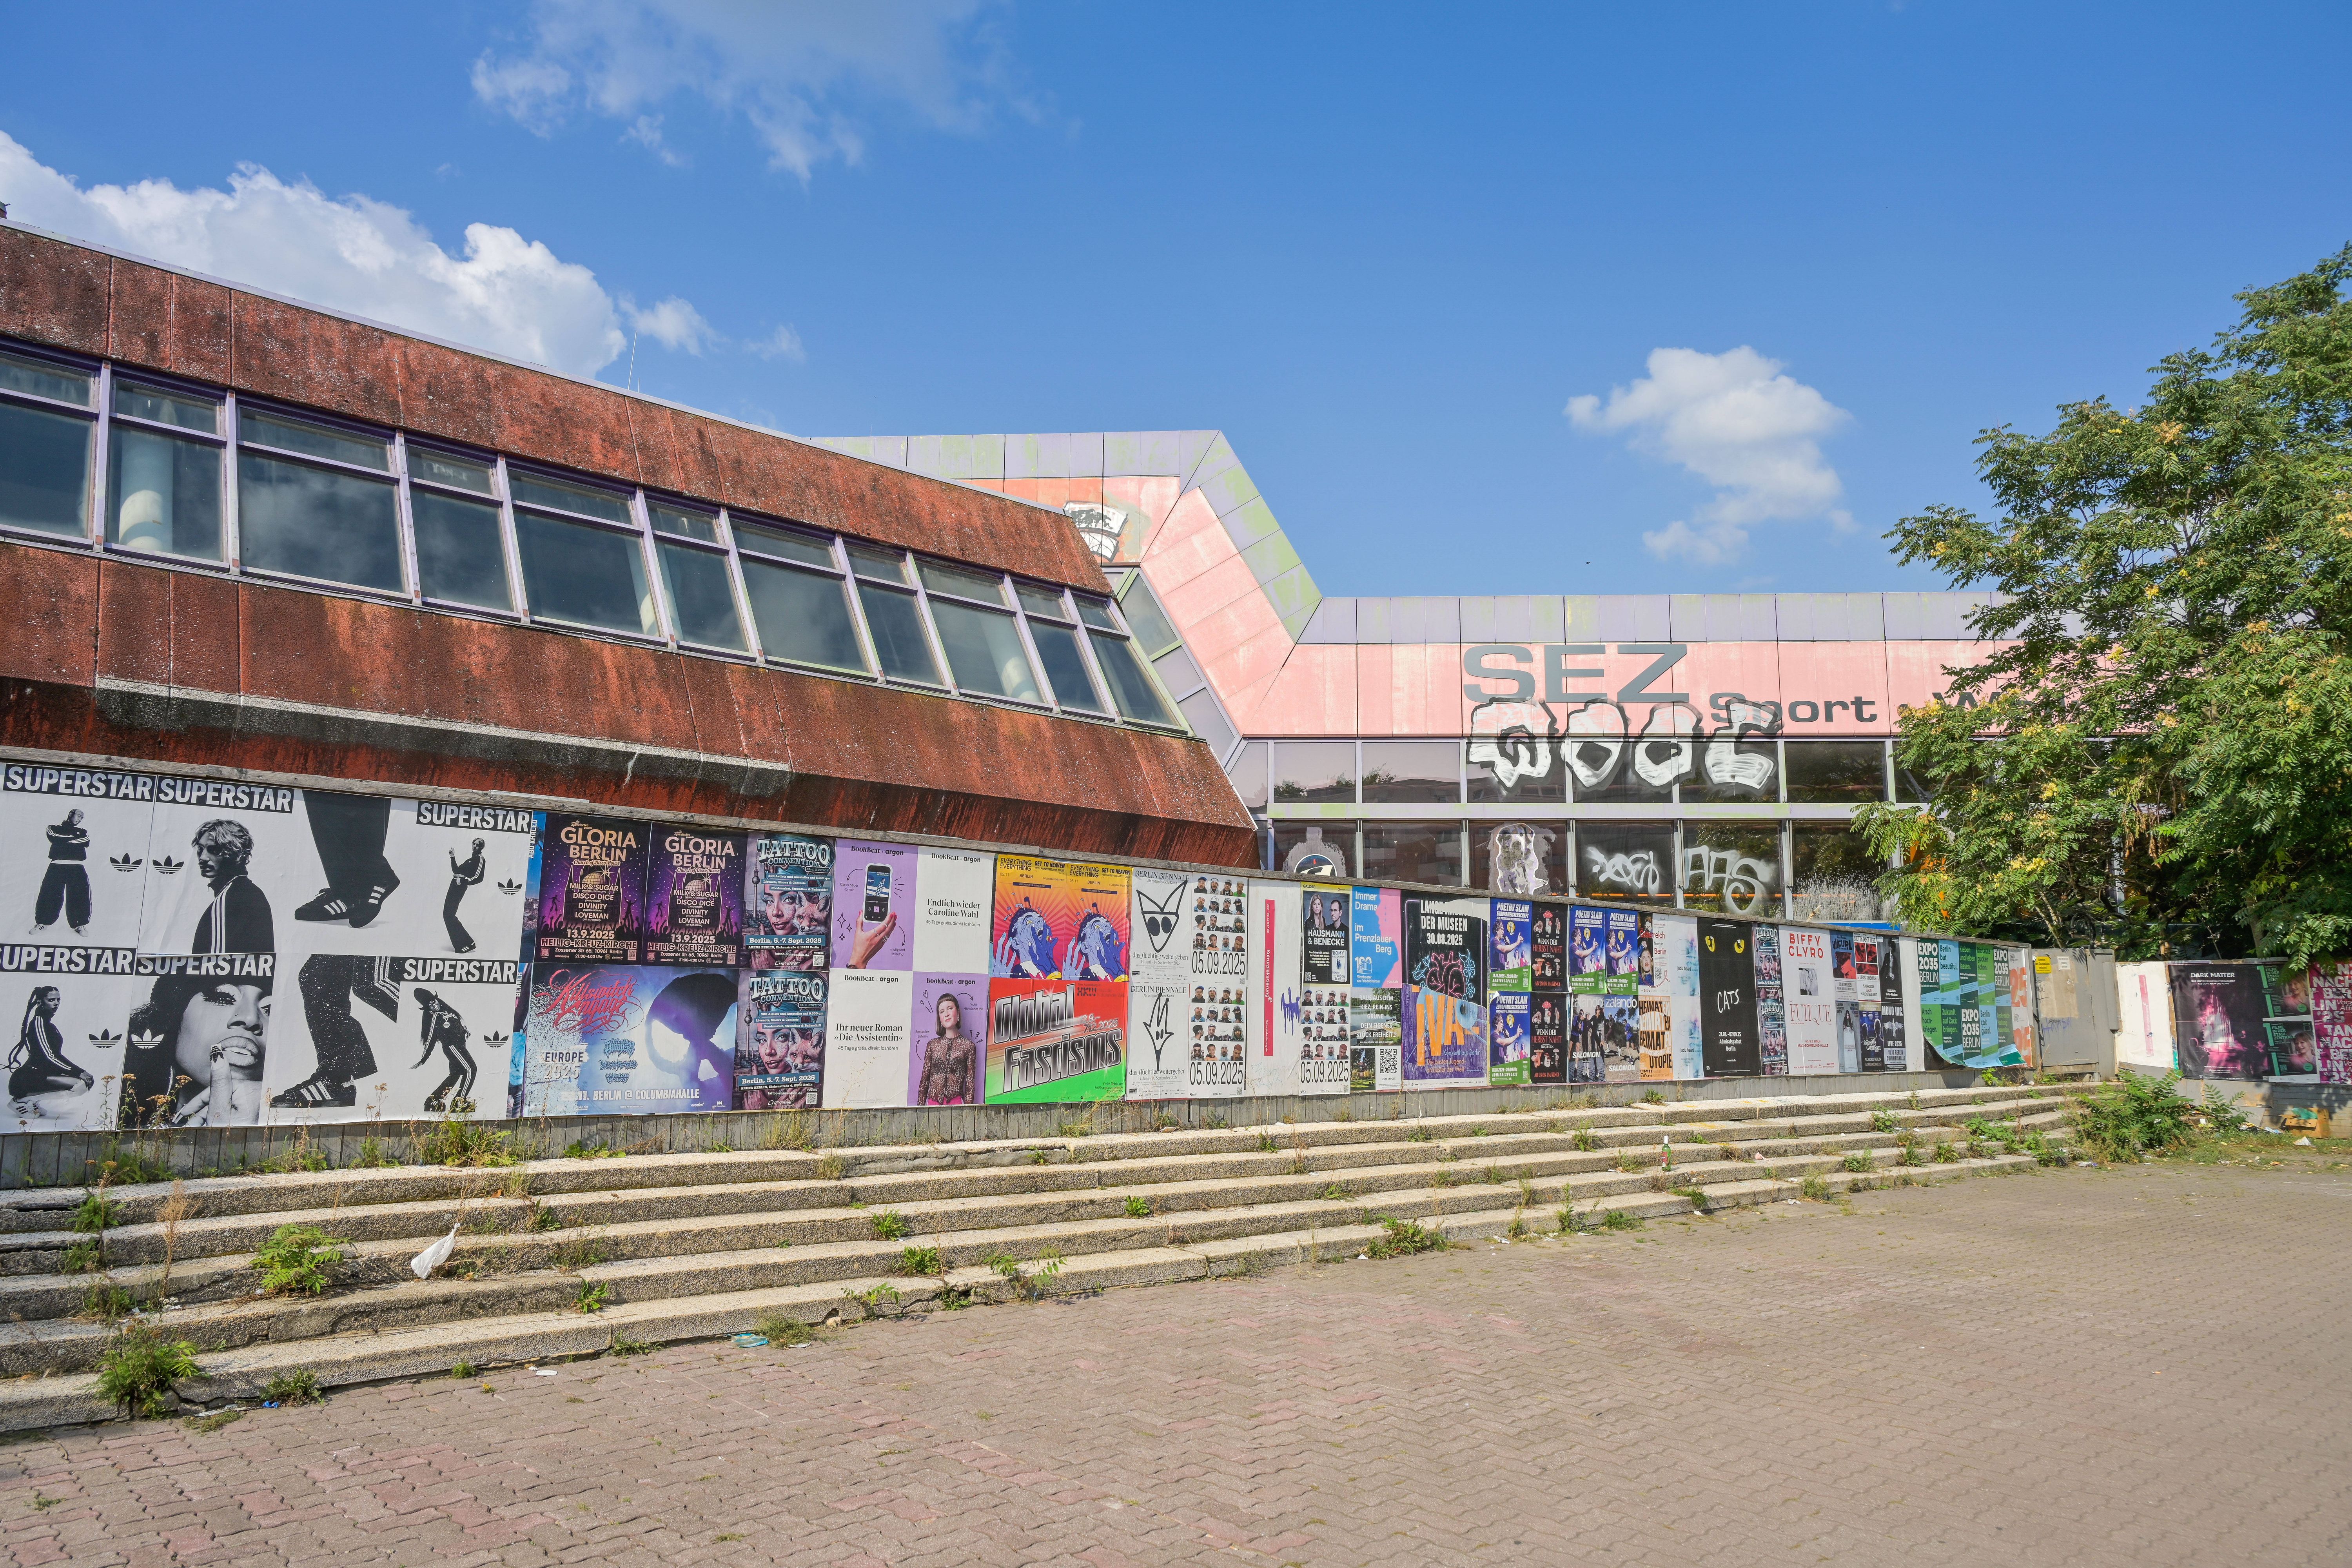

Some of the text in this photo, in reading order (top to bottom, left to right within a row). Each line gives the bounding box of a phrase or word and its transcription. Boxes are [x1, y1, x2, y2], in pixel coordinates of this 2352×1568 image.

[1463, 644, 1689, 703] SEZ
[5, 766, 154, 800] SUPERSTAR
[158, 779, 292, 812] SUPERSTAR
[419, 802, 530, 832] SUPERSTAR
[561, 827, 636, 848] GLORIA
[665, 837, 735, 856] GLORIA
[757, 839, 830, 866] TATTOO
[570, 845, 626, 861] BERLIN
[673, 854, 726, 869] BERLIN
[768, 858, 819, 867] CONVENTION
[1355, 891, 1377, 900] Immer
[927, 898, 955, 907] Endlich
[1355, 902, 1377, 911] Drama
[1497, 902, 1529, 913] POETRY SLAM
[960, 909, 978, 918] Wahl
[1575, 910, 1602, 919] POETRY SLAM
[1355, 923, 1363, 931] im
[1421, 916, 1467, 931] DER MUSEEN
[567, 929, 615, 939] 13.9.2025
[671, 934, 715, 944] 13.9.2025
[1308, 929, 1345, 938] HAUSMANN
[1355, 933, 1392, 943] Prenzlauer
[1427, 933, 1463, 946] 30.08.2025
[1789, 933, 1820, 946] BIFFY
[541, 938, 637, 949] HEILIG-KREUZ-KIRCHE
[1314, 937, 1344, 946] BENECKE
[648, 943, 736, 953] HEILIG-KREUZ-KIRCHE
[1376, 944, 1392, 955] Berg
[1789, 946, 1823, 958] CLYRO
[1918, 942, 1938, 956] EXPO
[138, 955, 274, 976] SUPERSTAR
[1192, 951, 1245, 976] 05.09.2025
[1919, 957, 1938, 970] 2035
[1940, 961, 1958, 970] beautiful.
[403, 959, 515, 982] SUPERSTAR
[1919, 971, 1938, 983] BERLIN
[1605, 997, 1637, 1008] zalando
[1717, 989, 1739, 1013] CATS
[994, 984, 1075, 1044] Global
[1790, 1004, 1831, 1025] FUTIQUE
[1882, 1006, 1894, 1016] MONO
[1895, 1007, 1903, 1016] INC.
[834, 1033, 853, 1041] »Die
[545, 1053, 584, 1062] EUROPE
[1003, 1029, 1122, 1094] Fascisms
[1649, 1054, 1671, 1069] UTOPIE
[1190, 1062, 1243, 1085] 05.09.2025
[593, 1090, 621, 1100] BERLIN
[636, 1089, 699, 1100] COLUMBIAHALLE
